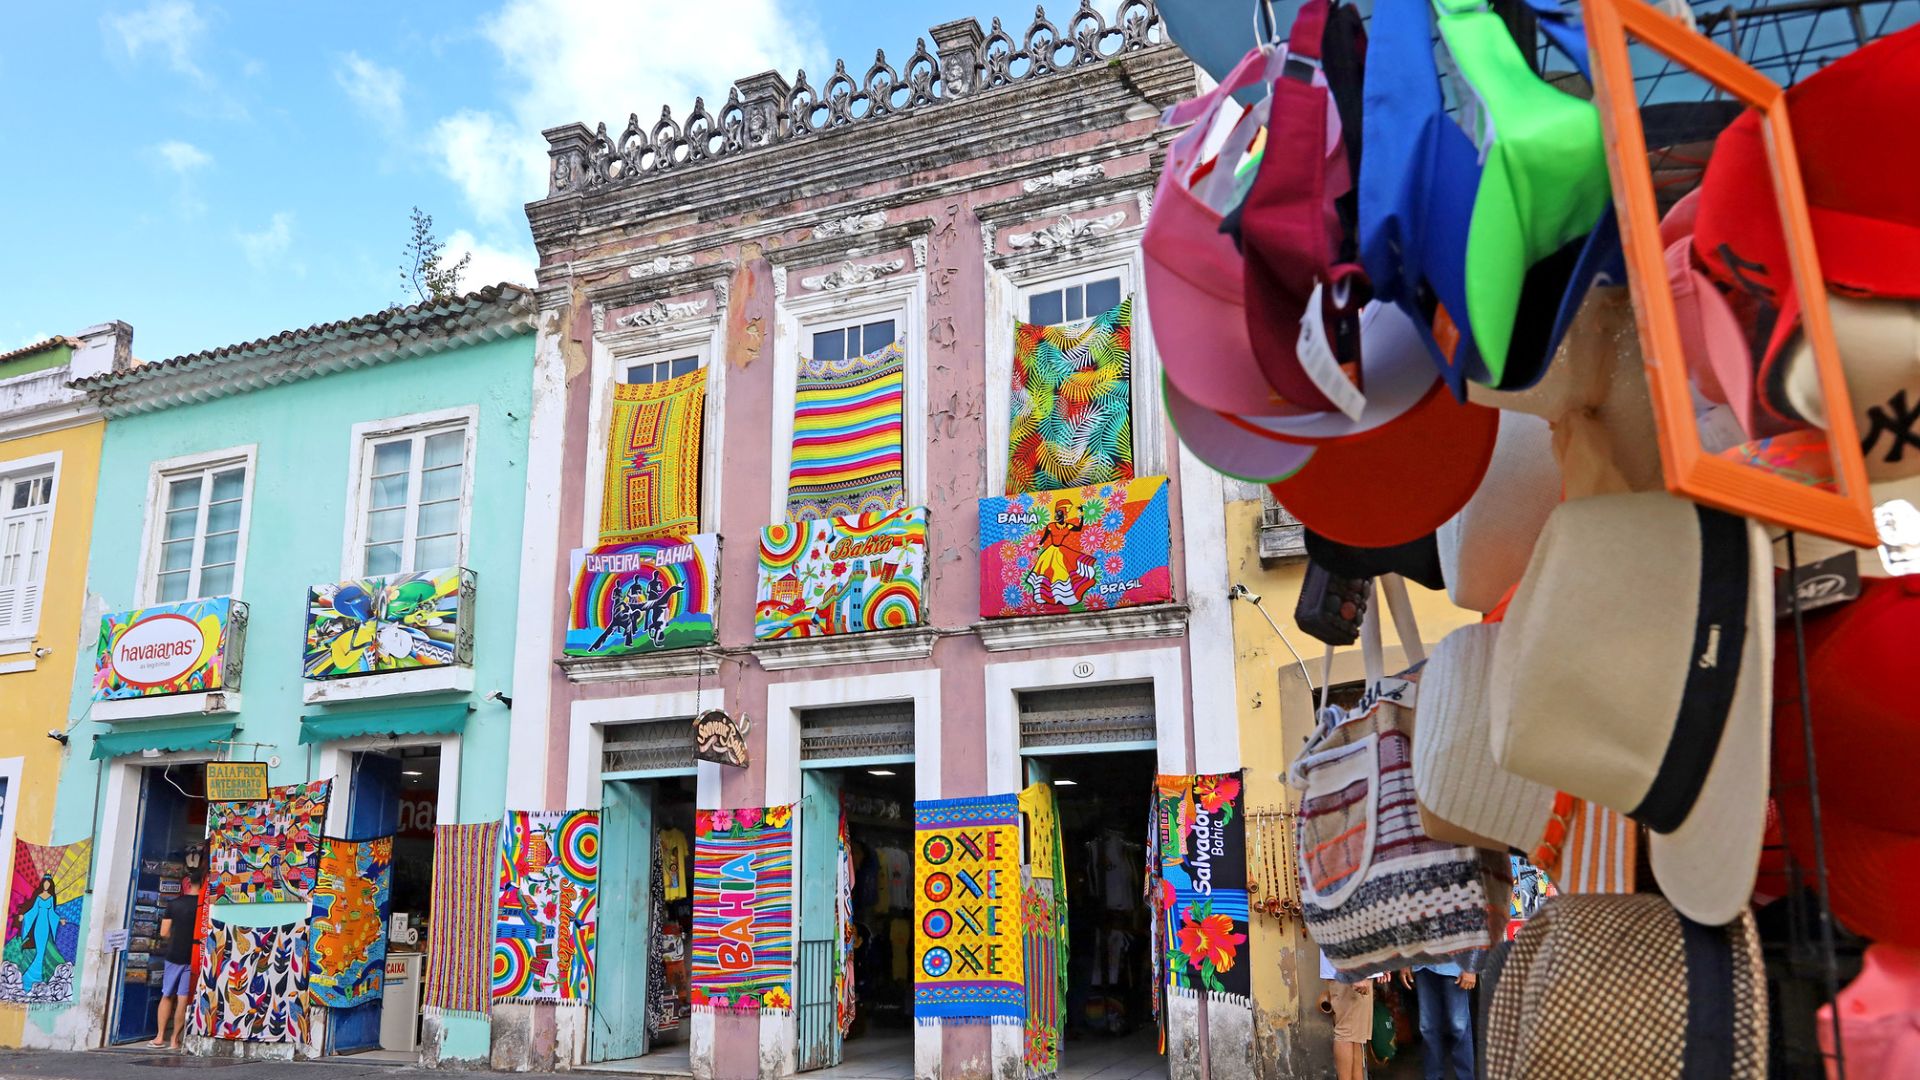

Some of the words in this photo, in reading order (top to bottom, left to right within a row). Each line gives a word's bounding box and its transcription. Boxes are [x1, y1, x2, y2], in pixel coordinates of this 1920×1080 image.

[997, 512, 1039, 525] BAHIA
[586, 553, 640, 573] CAPOEIRA
[655, 543, 694, 567] BAHIA
[830, 535, 894, 561] Bahia
[1100, 580, 1143, 595] BRASIL
[121, 640, 193, 662] havaianas
[1078, 664, 1089, 675] 10
[208, 766, 266, 778] BAIAFRICA
[210, 778, 262, 788] ARTESANATO
[397, 799, 437, 832] na
[923, 831, 1003, 865] OXE
[1191, 803, 1212, 896] Salvador
[1210, 819, 1225, 857] Bahia
[924, 869, 1003, 903] OXE
[557, 877, 577, 972] Salvador
[717, 852, 757, 971] BAHIA
[922, 905, 1003, 939] OXE
[386, 962, 406, 974] CAIXA
[922, 944, 1003, 978] OXE
